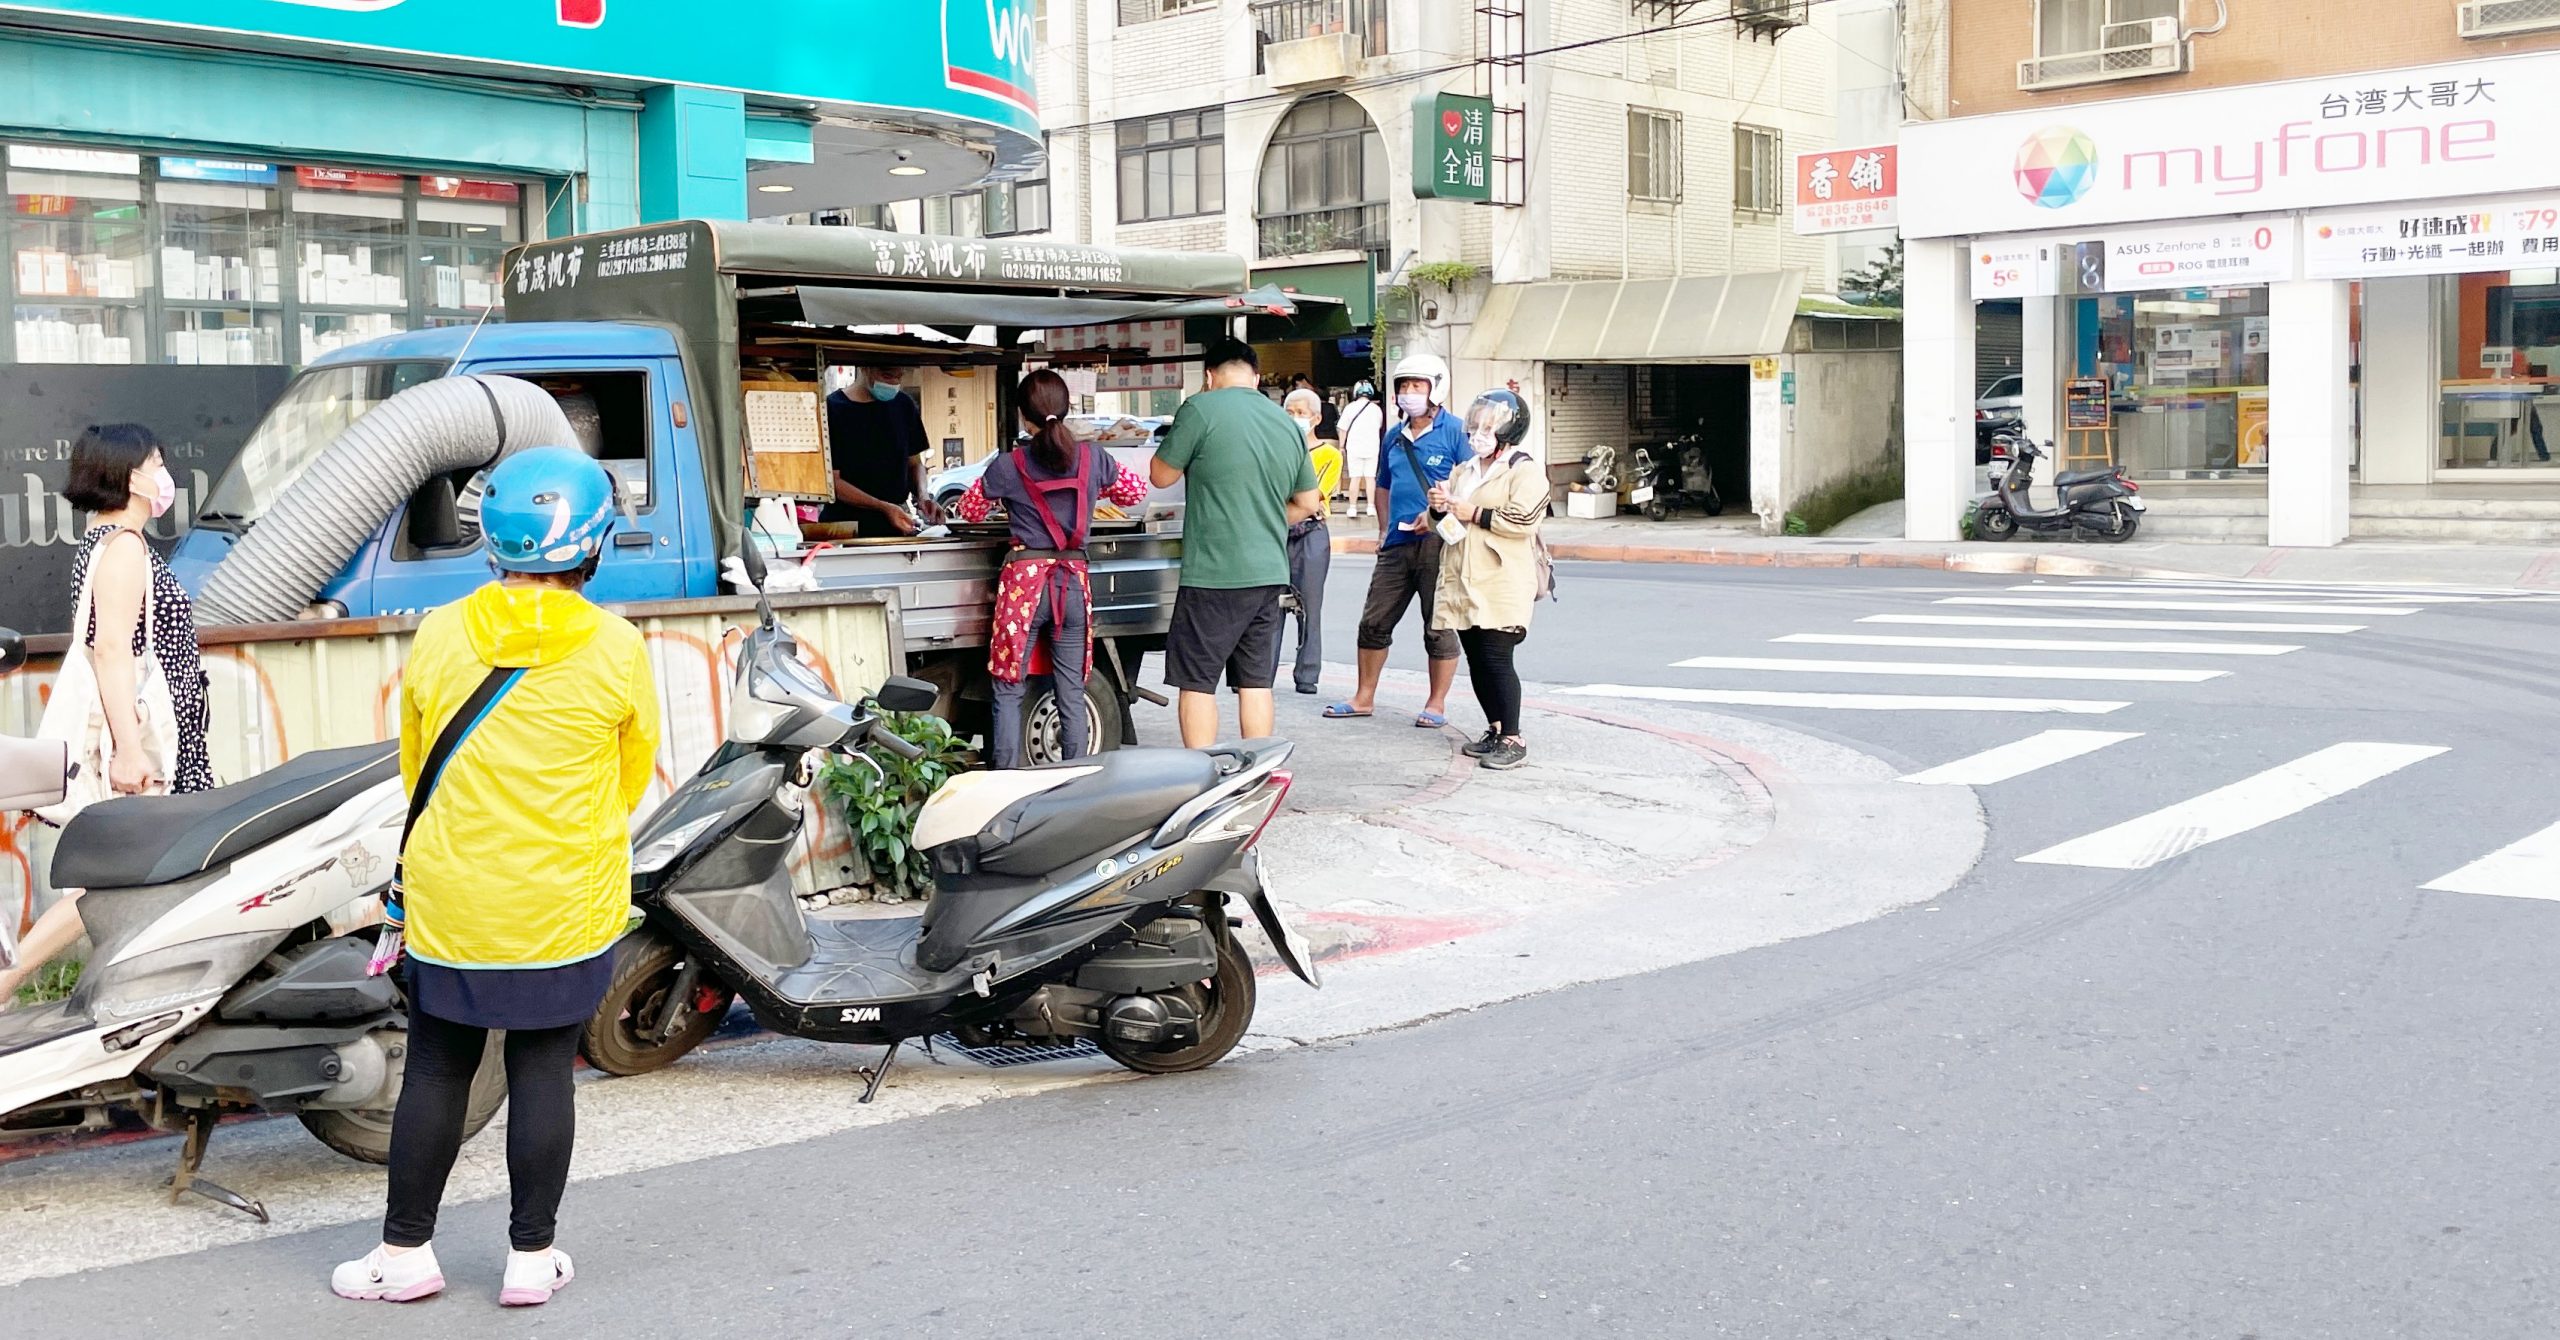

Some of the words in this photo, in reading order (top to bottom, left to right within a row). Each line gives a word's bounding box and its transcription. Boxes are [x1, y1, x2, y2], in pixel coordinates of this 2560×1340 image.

[2123, 119, 2496, 196] myfone
[2116, 243, 2151, 255] ASUS
[2156, 239, 2207, 253] Zenfone
[2213, 238, 2221, 248] 8
[870, 240, 987, 280] 富晟帆布
[2178, 261, 2203, 271] ROG
[516, 246, 584, 294] 富晟帆布
[1993, 269, 2019, 287] 5G
[840, 1007, 881, 1023] SYM
